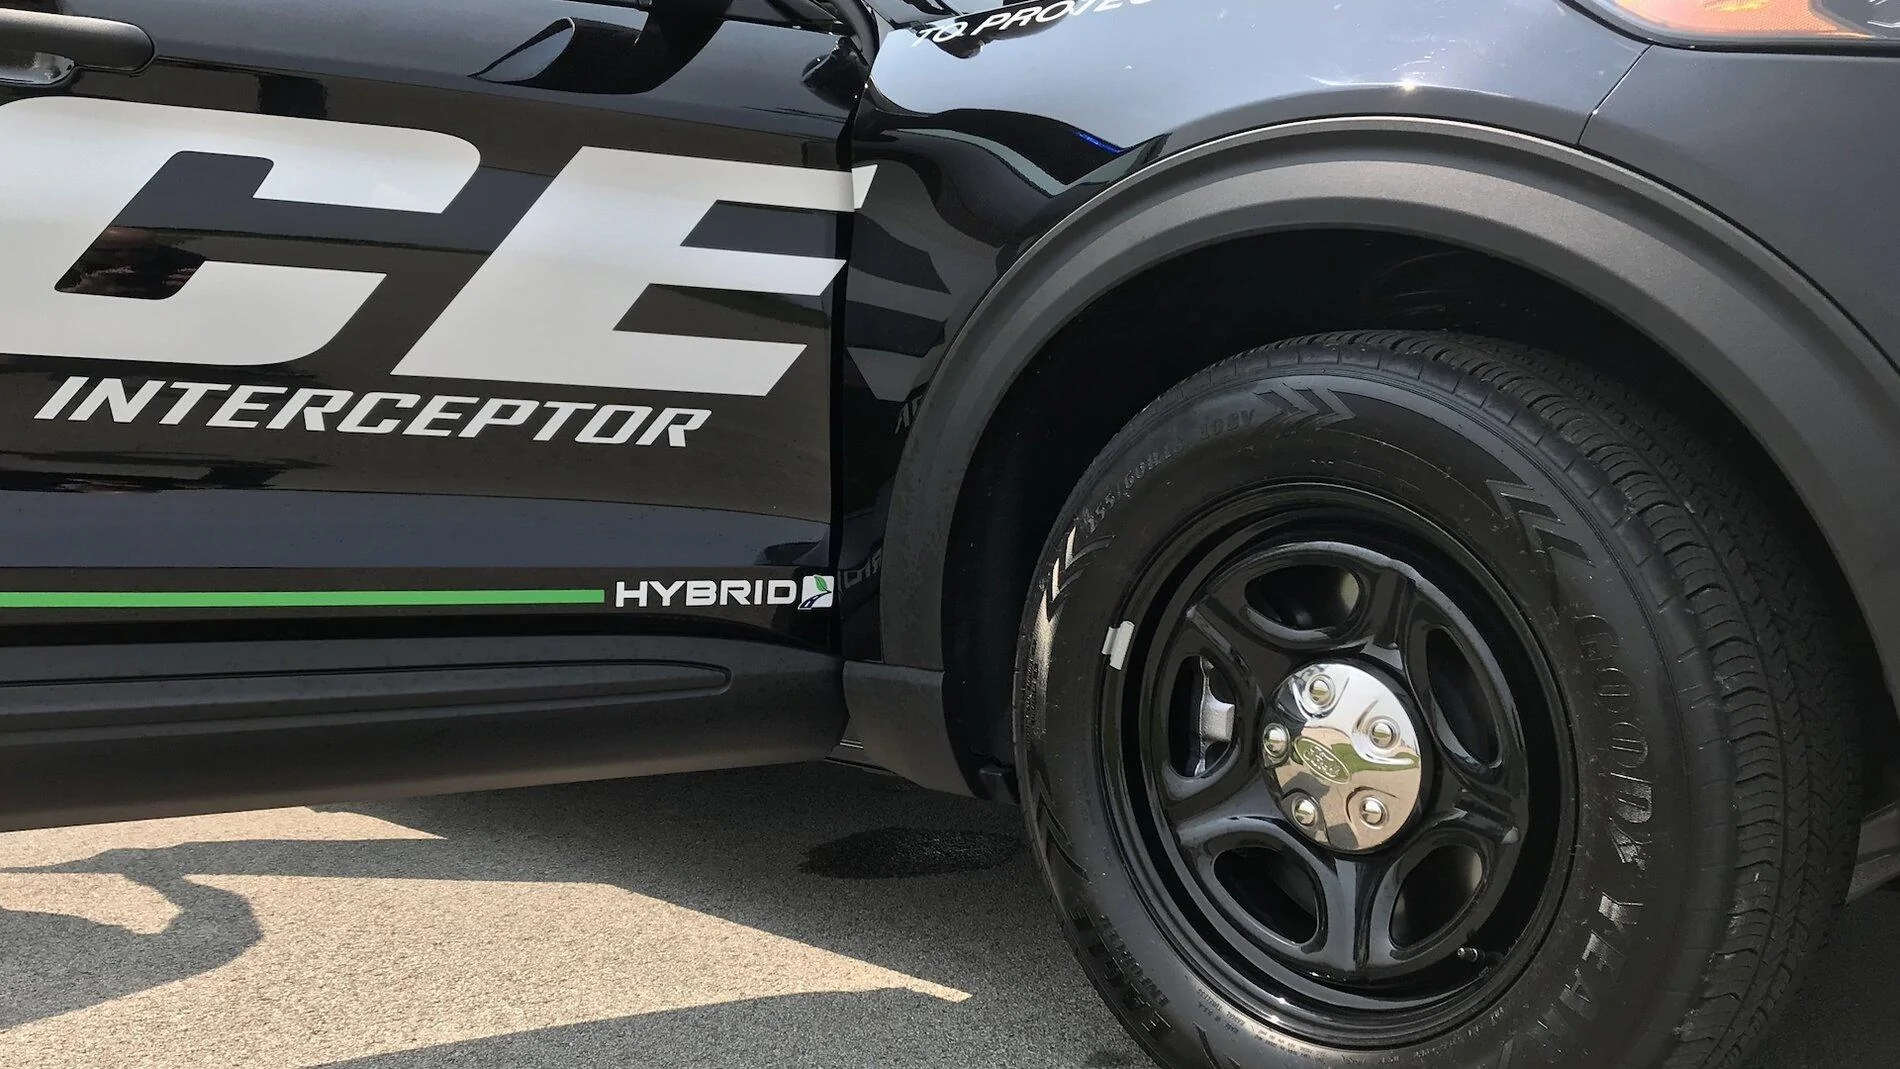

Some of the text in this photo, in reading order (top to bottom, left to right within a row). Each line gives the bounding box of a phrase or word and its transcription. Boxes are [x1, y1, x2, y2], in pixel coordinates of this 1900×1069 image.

[911, 22, 968, 47] TO
[0, 97, 878, 397] CE
[34, 376, 712, 448] INTERCEPTOR
[615, 579, 798, 608] HYBRID
